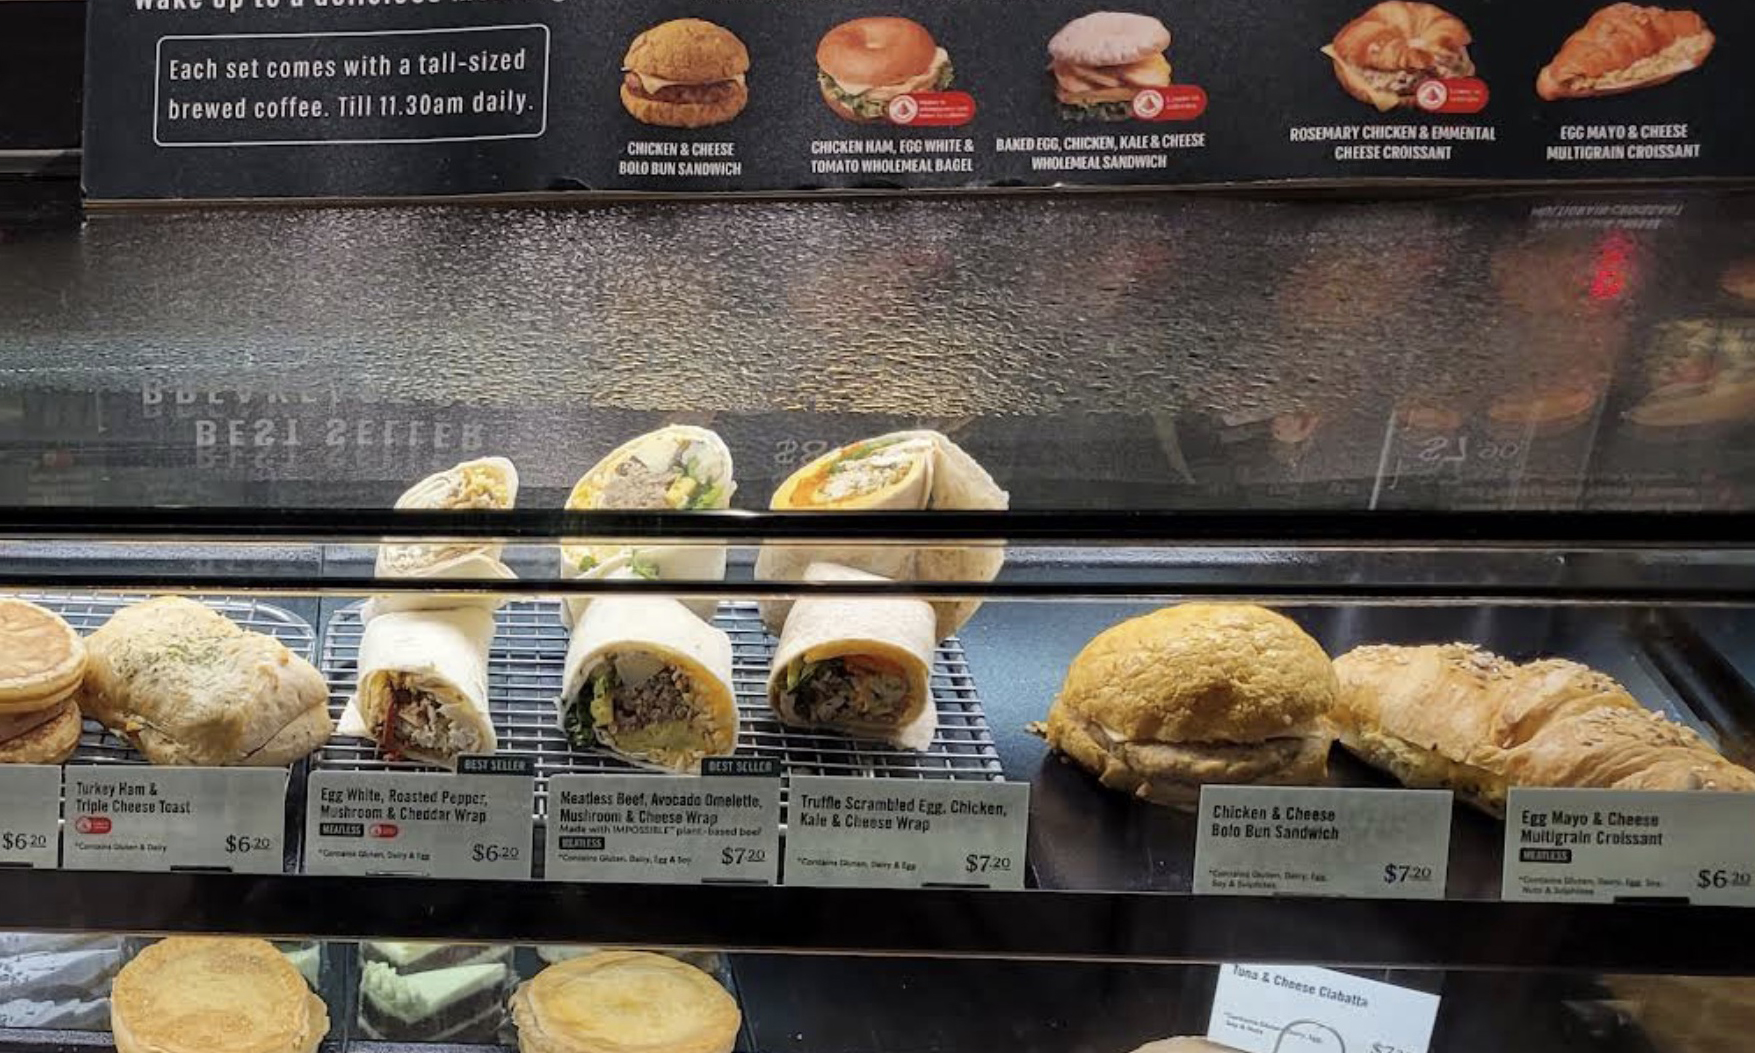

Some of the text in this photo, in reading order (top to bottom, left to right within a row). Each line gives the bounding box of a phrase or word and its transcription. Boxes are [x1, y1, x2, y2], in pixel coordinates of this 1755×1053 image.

[170, 49, 526, 79] Each set comes with a tall-sized
[168, 89, 533, 120] brewed coffee. Till 11.30am daily.
[1290, 125, 1496, 142] ROSEMARY CHICKEN & EMMENTAL
[1561, 124, 1687, 140] EGG MAYO & CHEESE
[627, 141, 735, 157] CHICKEN & CHEESE
[1335, 144, 1453, 161] CHEESE CROISSANT
[1547, 143, 1700, 161] MULTIGRAIN CROISSANT
[619, 160, 742, 176] BOLO BUN SANDWICH
[464, 758, 526, 772] BEST SELLER
[321, 788, 488, 807] Egg White, Roasted Pepper,
[321, 805, 487, 824] Mushroom & Cheddar Wrap
[1213, 804, 1336, 822] Chicken & Cheese
[1522, 810, 1659, 829] Egg Mayo & Cheese
[2, 832, 46, 850] $6.20
[1211, 823, 1339, 842] Bolo Bun Sandwich
[1521, 828, 1663, 848] Multigrain Croissant
[472, 844, 519, 864] $6.20
[1384, 863, 1432, 885] $7.20
[1697, 868, 1751, 890] $6.20
[1233, 964, 1369, 1008] Tuna & Cheese Ciabatta
